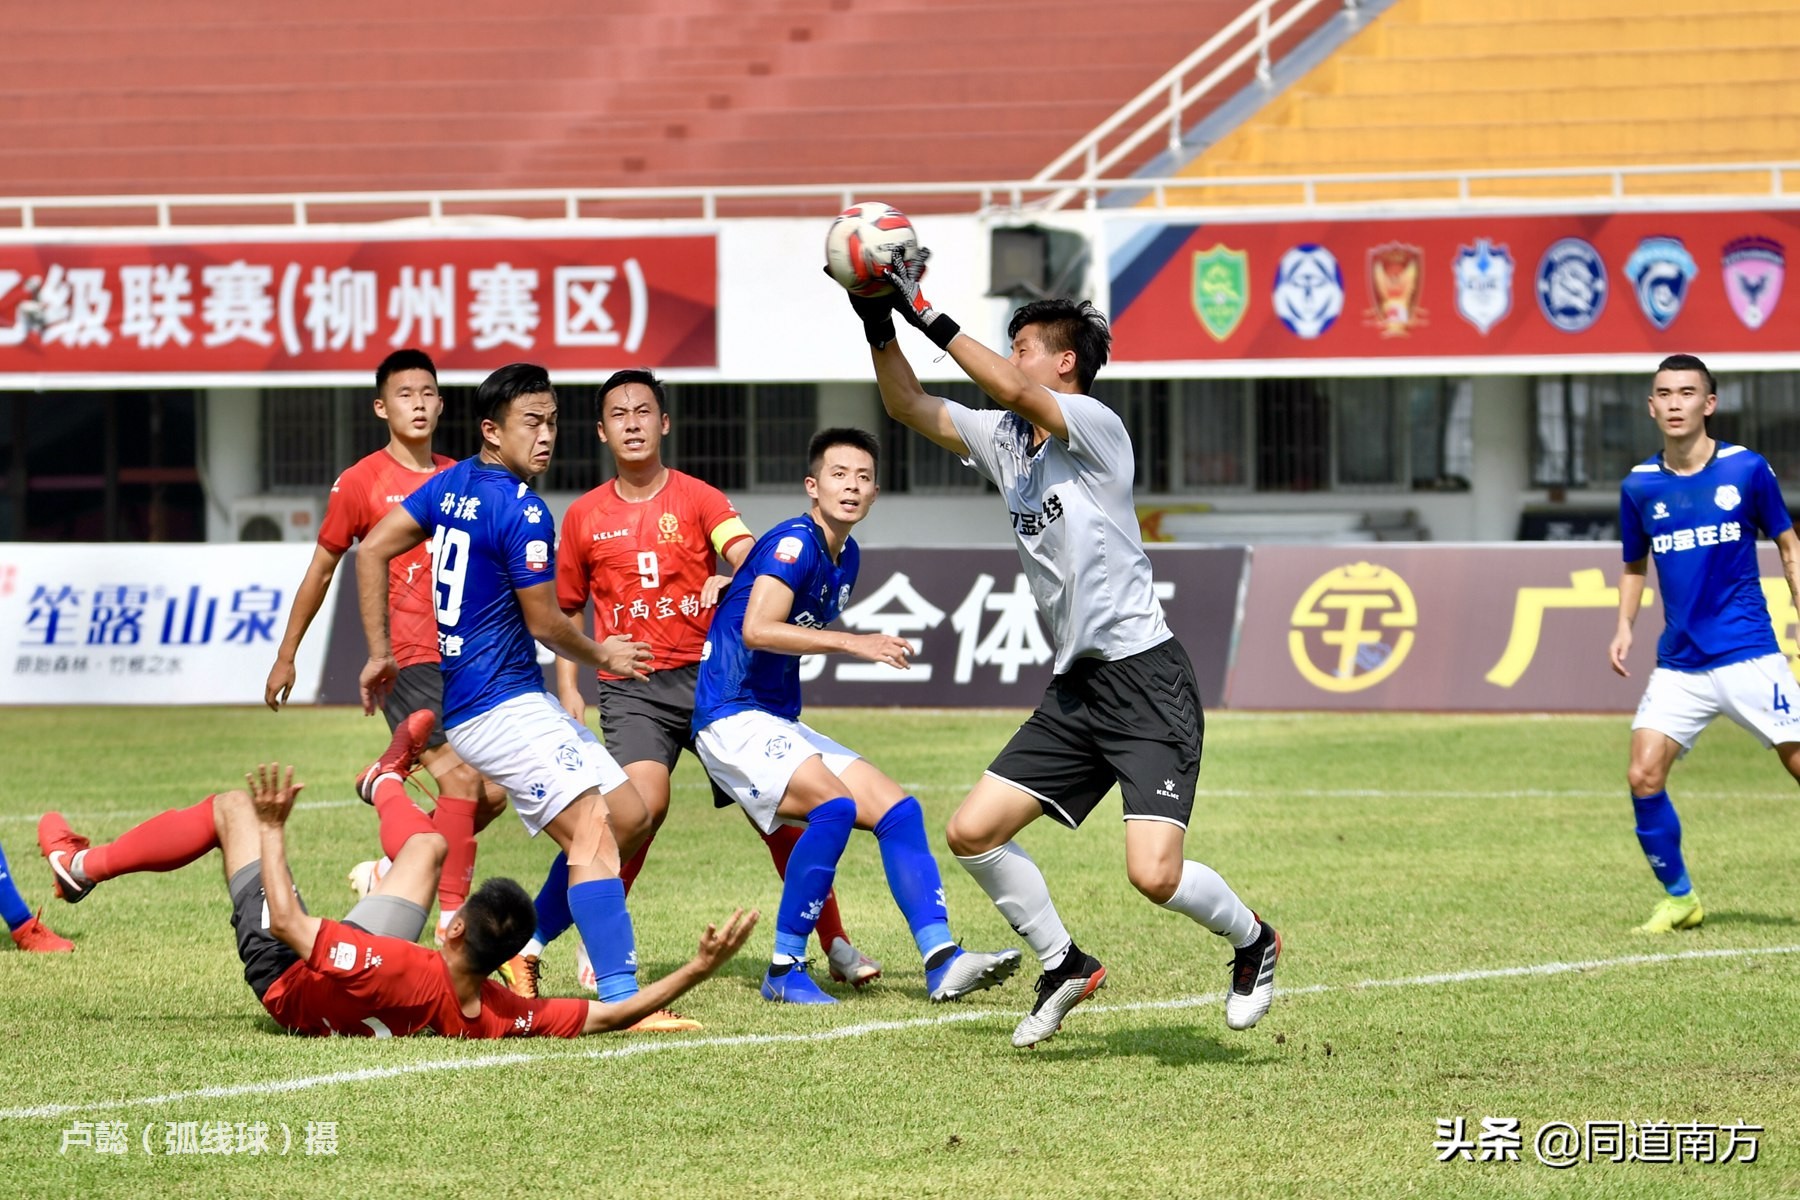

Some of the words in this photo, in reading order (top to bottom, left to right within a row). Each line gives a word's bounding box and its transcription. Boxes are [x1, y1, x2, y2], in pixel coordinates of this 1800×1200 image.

[593, 528, 629, 542] KELME
[1652, 521, 1741, 554] 中金在线
[430, 524, 471, 627] 19
[637, 551, 660, 589] 9
[612, 594, 700, 628] 广西宝韵
[1774, 683, 1790, 714] 4
[1156, 788, 1180, 800] KELME
